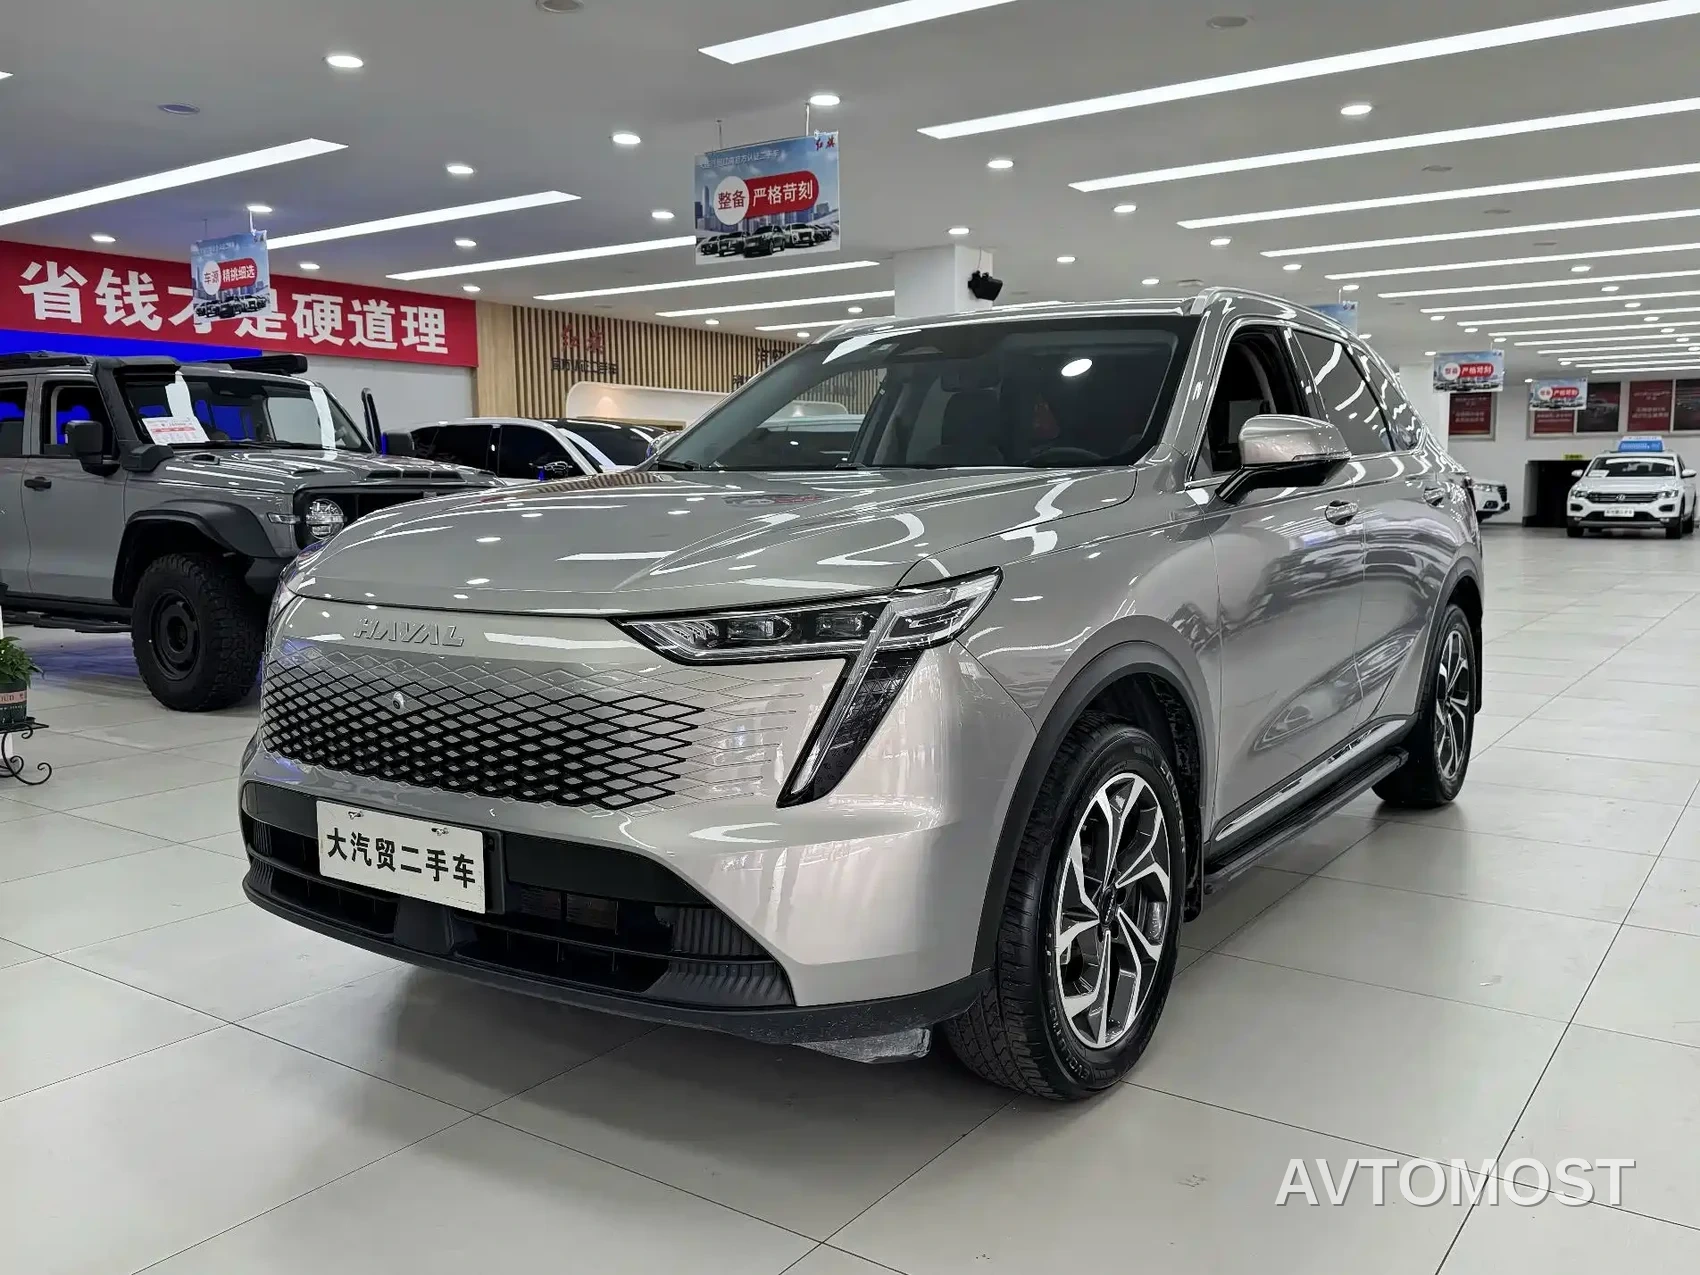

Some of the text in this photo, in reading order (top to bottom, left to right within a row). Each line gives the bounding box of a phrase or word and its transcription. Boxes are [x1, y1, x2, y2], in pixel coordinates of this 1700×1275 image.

[717, 179, 813, 210] 整备 严格苛刻
[222, 264, 256, 282] 精挑细选
[353, 618, 465, 647] HAVAL
[326, 827, 476, 889] 大汽贸二手车
